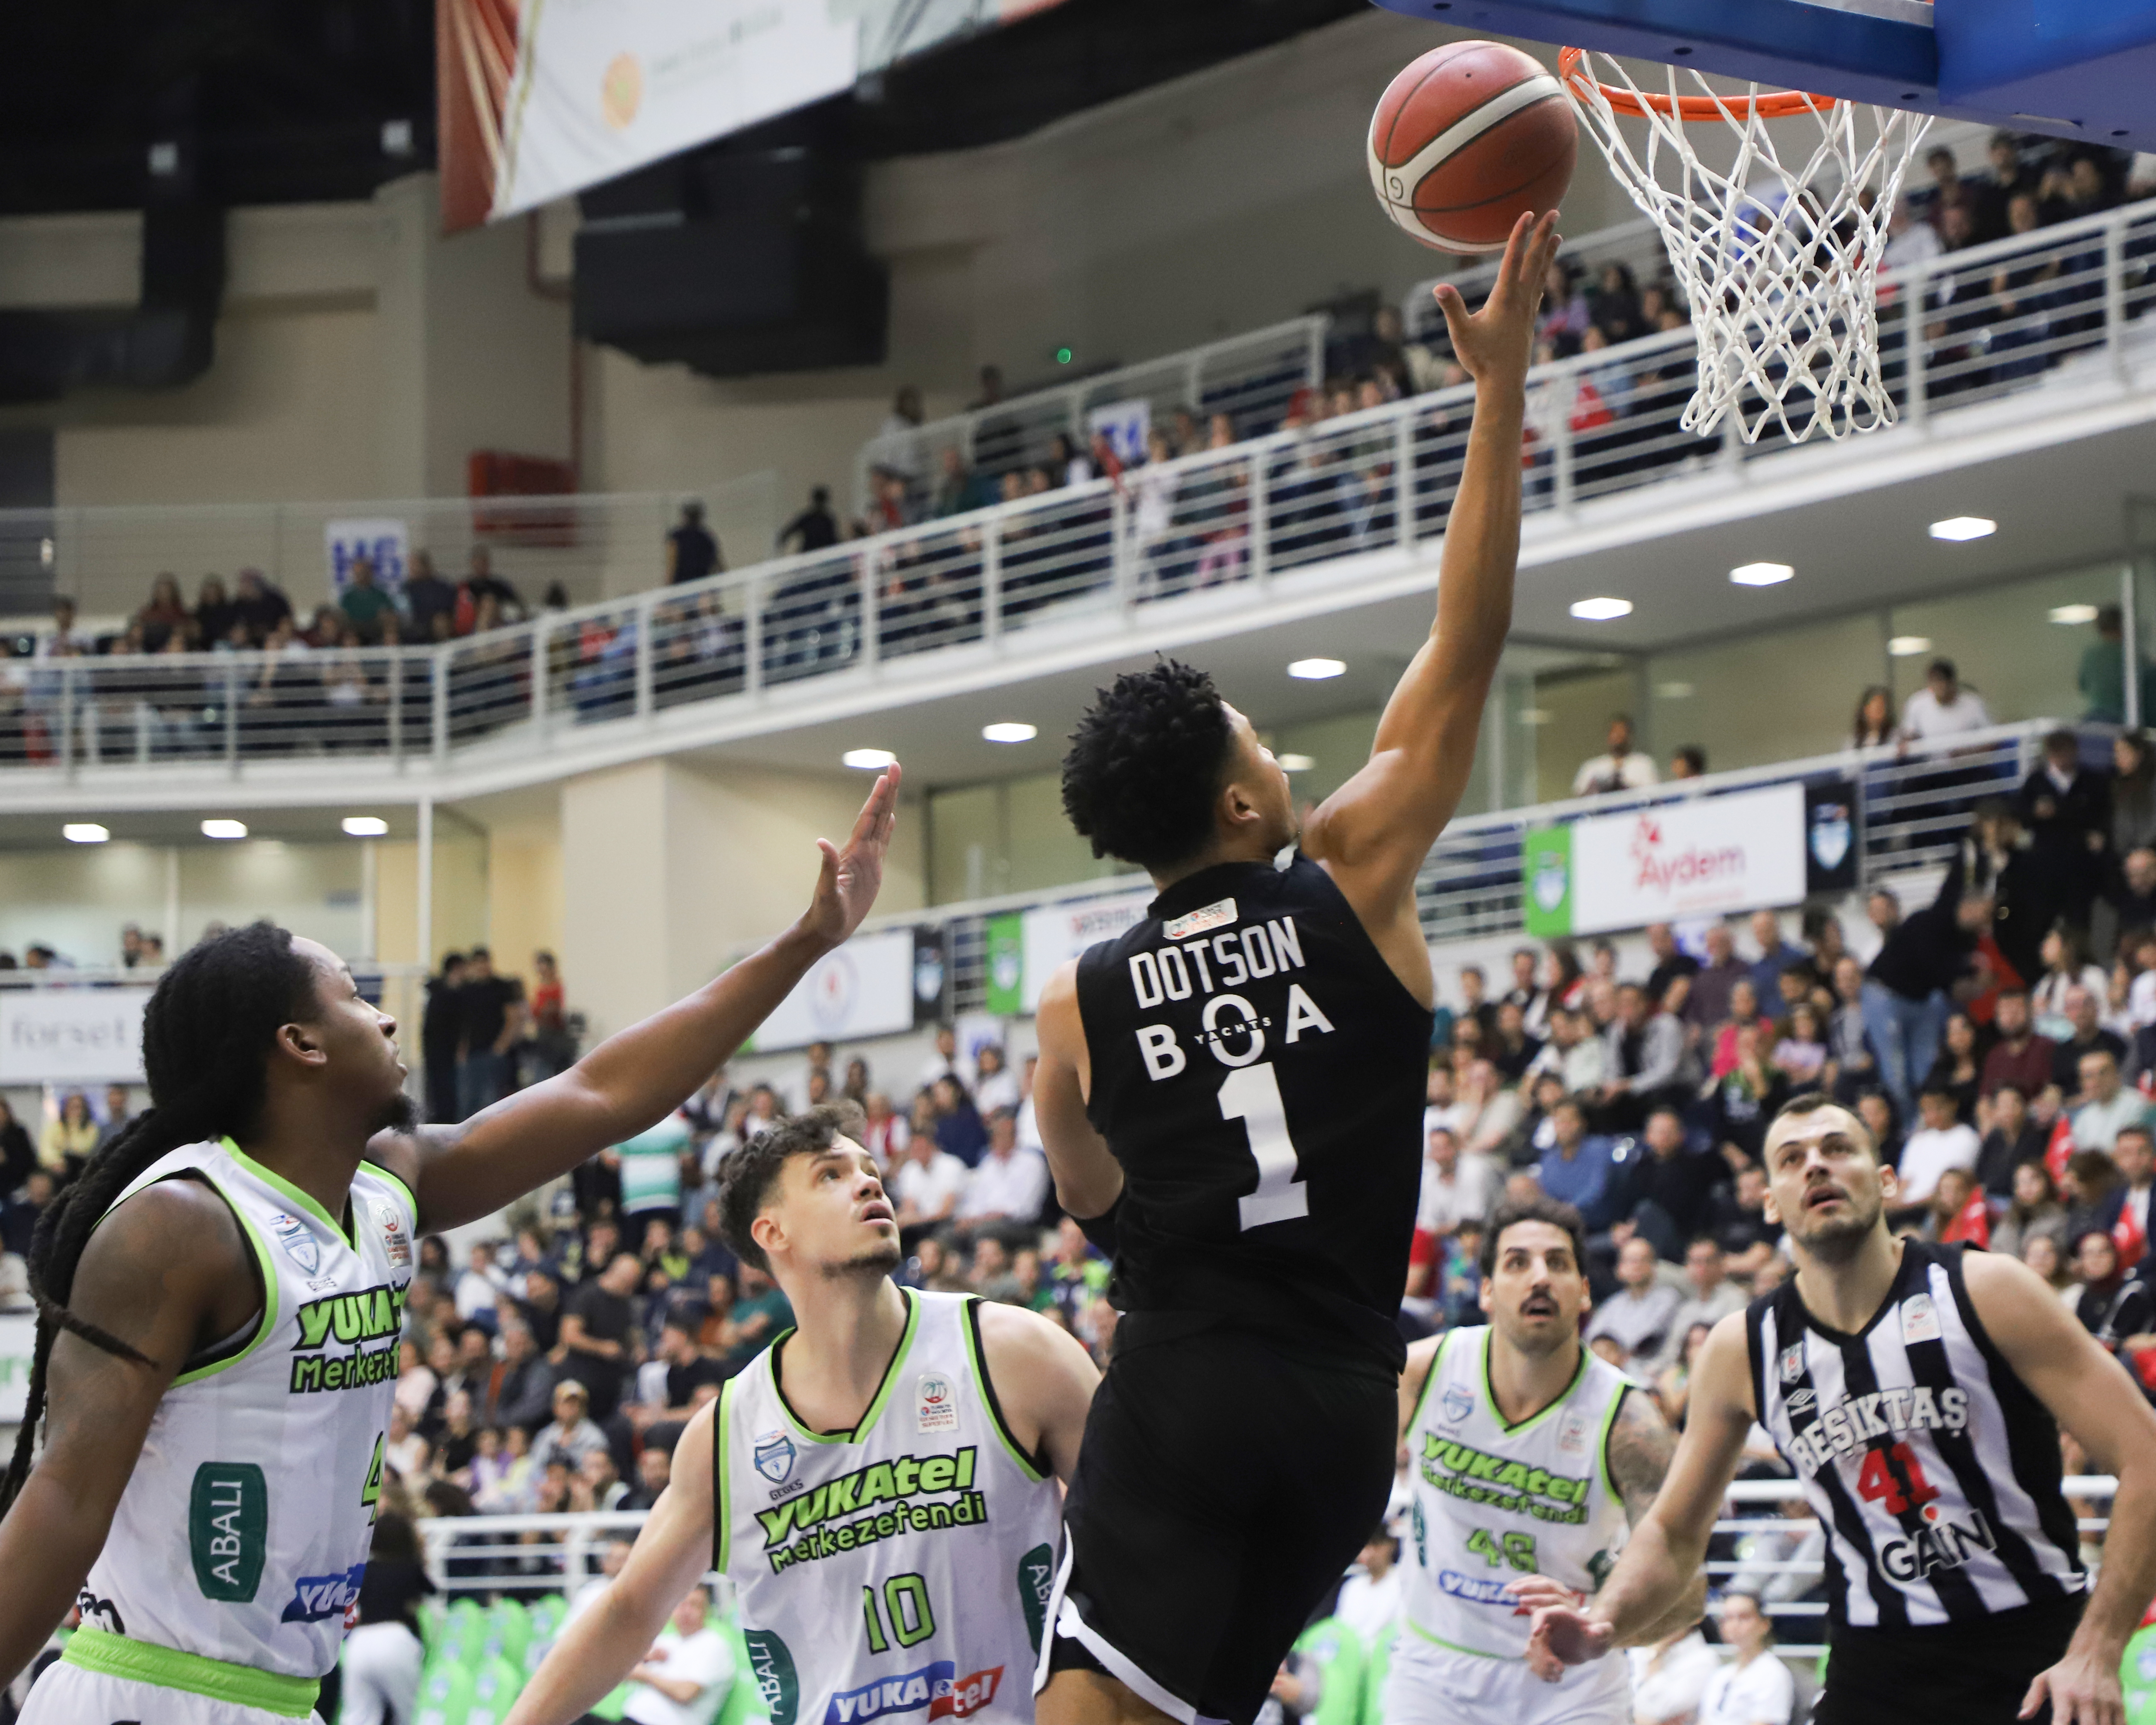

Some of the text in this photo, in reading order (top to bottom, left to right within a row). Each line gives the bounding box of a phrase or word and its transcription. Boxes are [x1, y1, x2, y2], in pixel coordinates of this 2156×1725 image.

[1129, 916, 1305, 1009] DOTSON
[1194, 1017, 1272, 1045] YACHTS
[1217, 1062, 1309, 1232] 1
[754, 1446, 978, 1550] YUKAtel
[1421, 1431, 1593, 1504] YUKAtel
[1857, 1441, 1940, 1515] 41
[211, 1480, 242, 1586] ABALI
[767, 1491, 988, 1575] Merkezefendi
[863, 1572, 935, 1655] 10
[749, 1642, 784, 1716] ABALI
